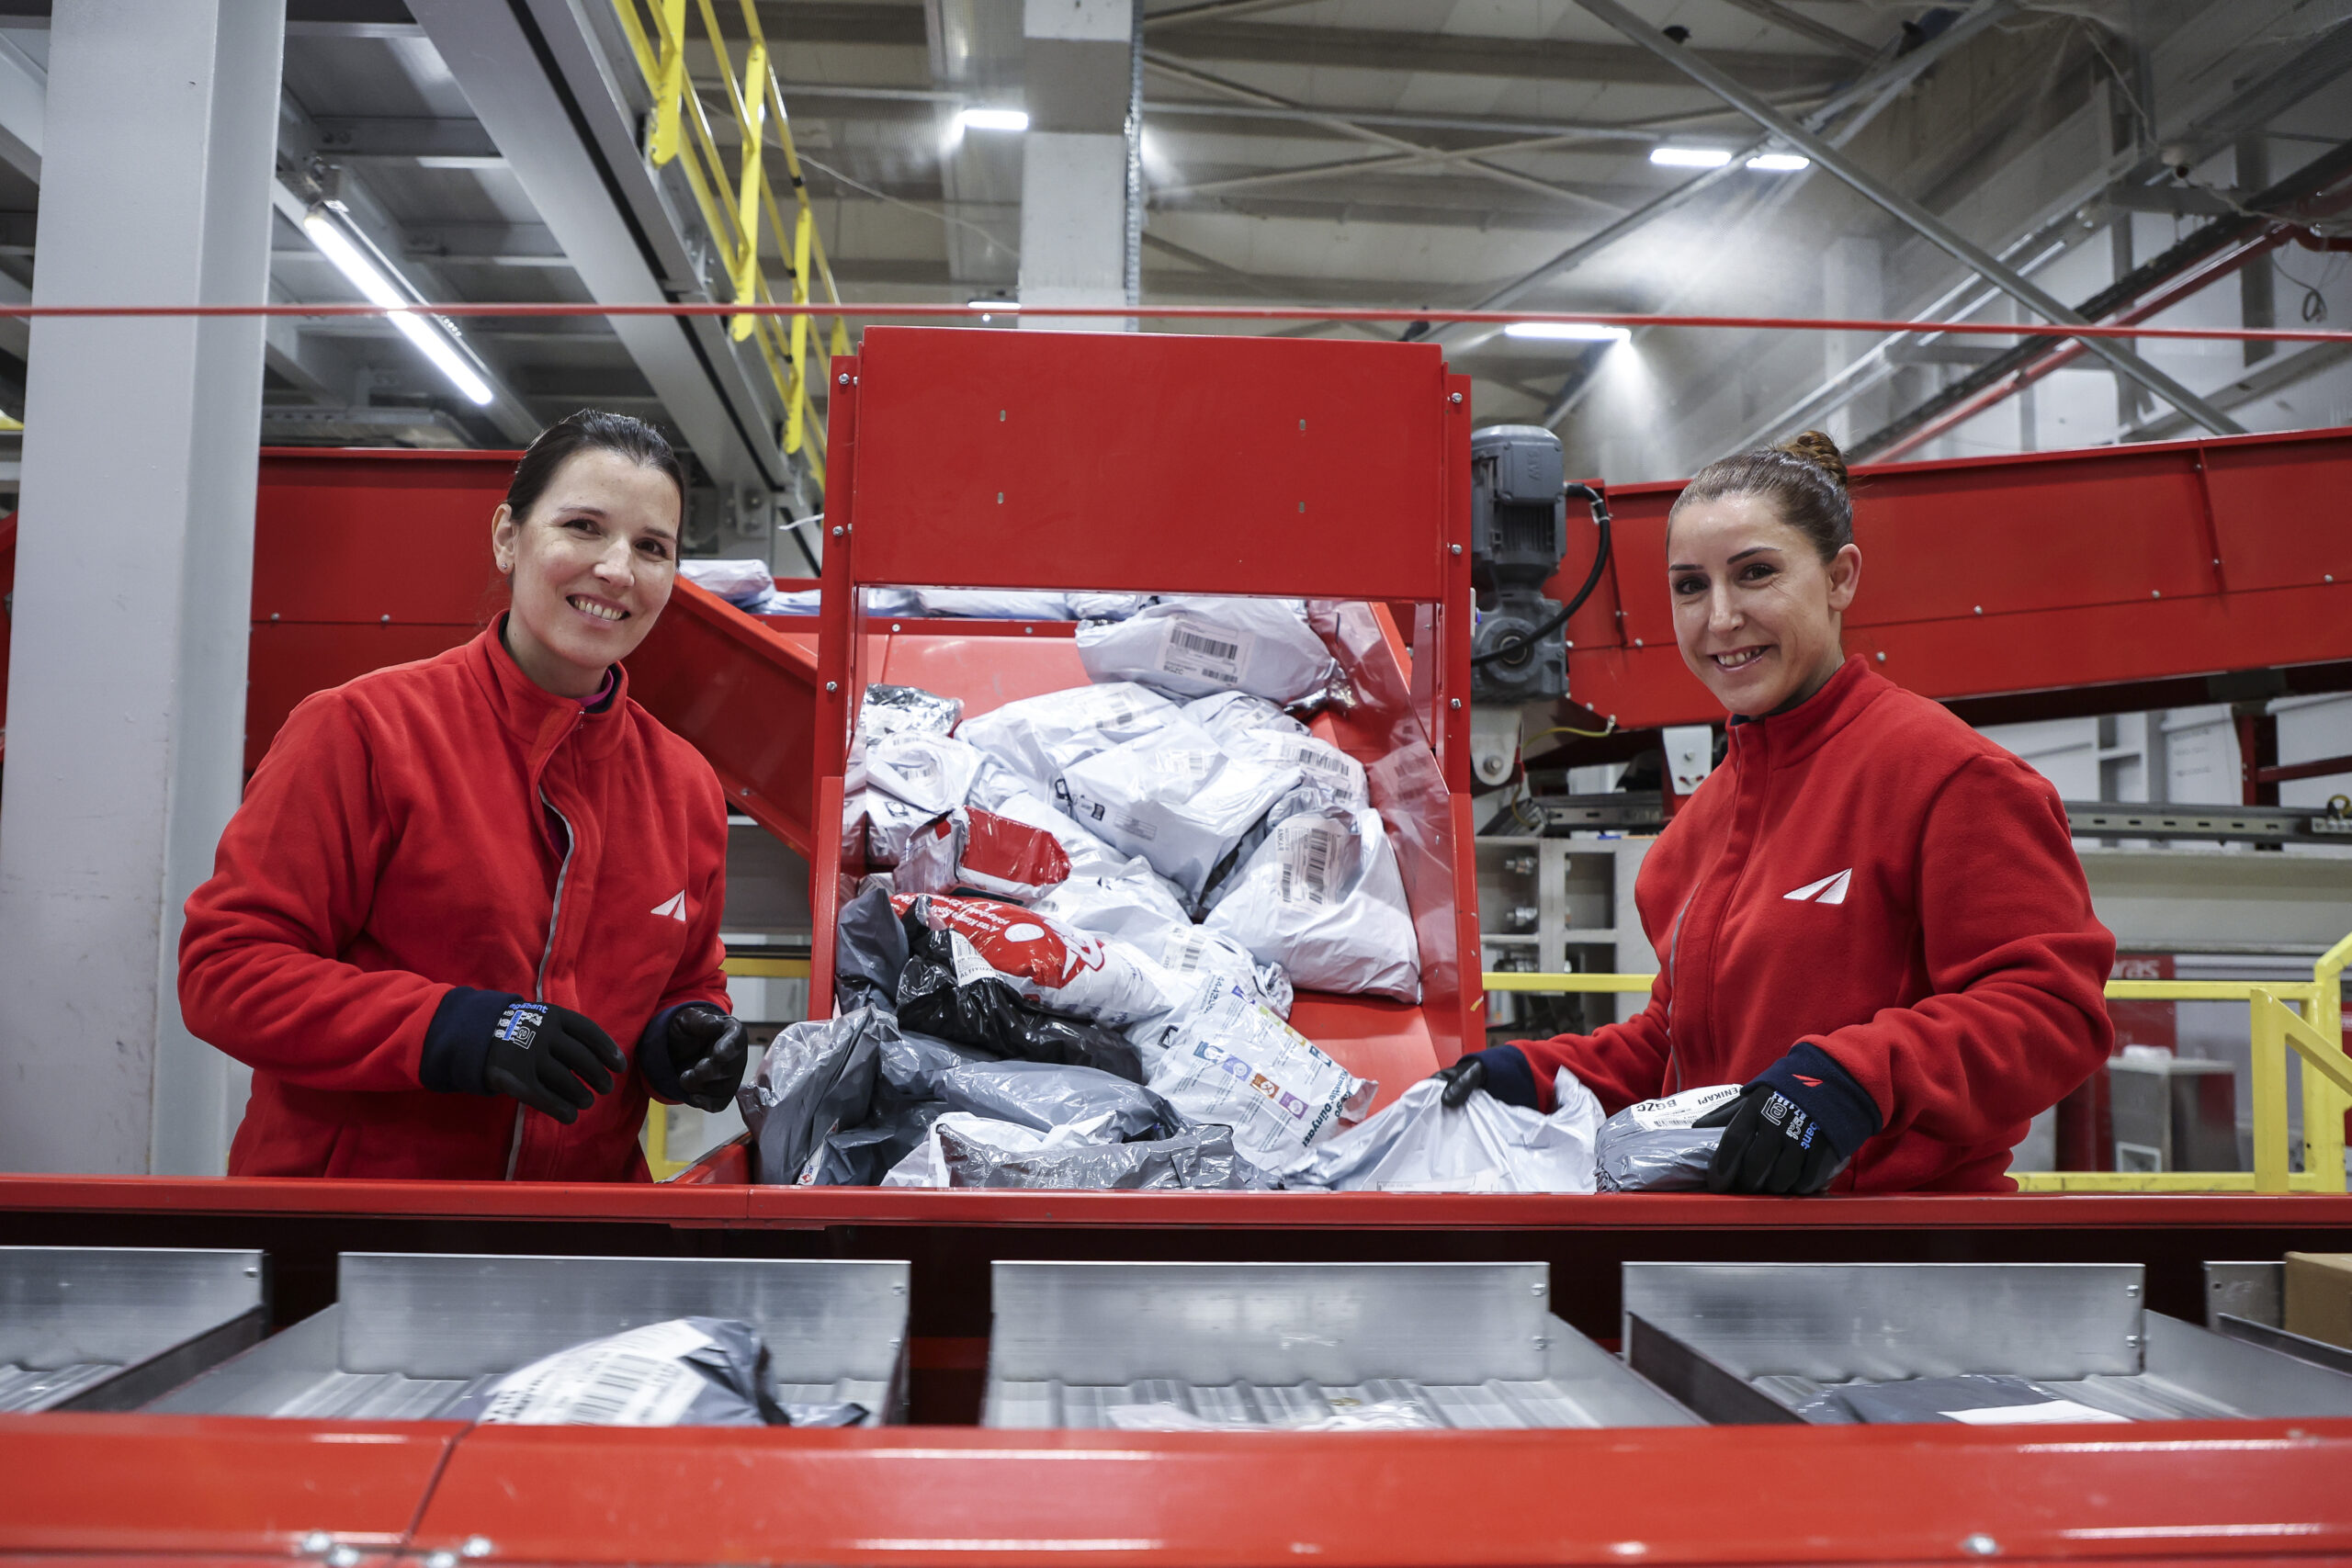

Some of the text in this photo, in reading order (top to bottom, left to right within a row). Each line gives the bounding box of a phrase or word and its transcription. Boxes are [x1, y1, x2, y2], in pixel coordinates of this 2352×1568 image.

[1636, 1100, 1677, 1112] BGZC
[1697, 1088, 1742, 1106] ENIKAPI
[1302, 1102, 1332, 1147] Dünyası
